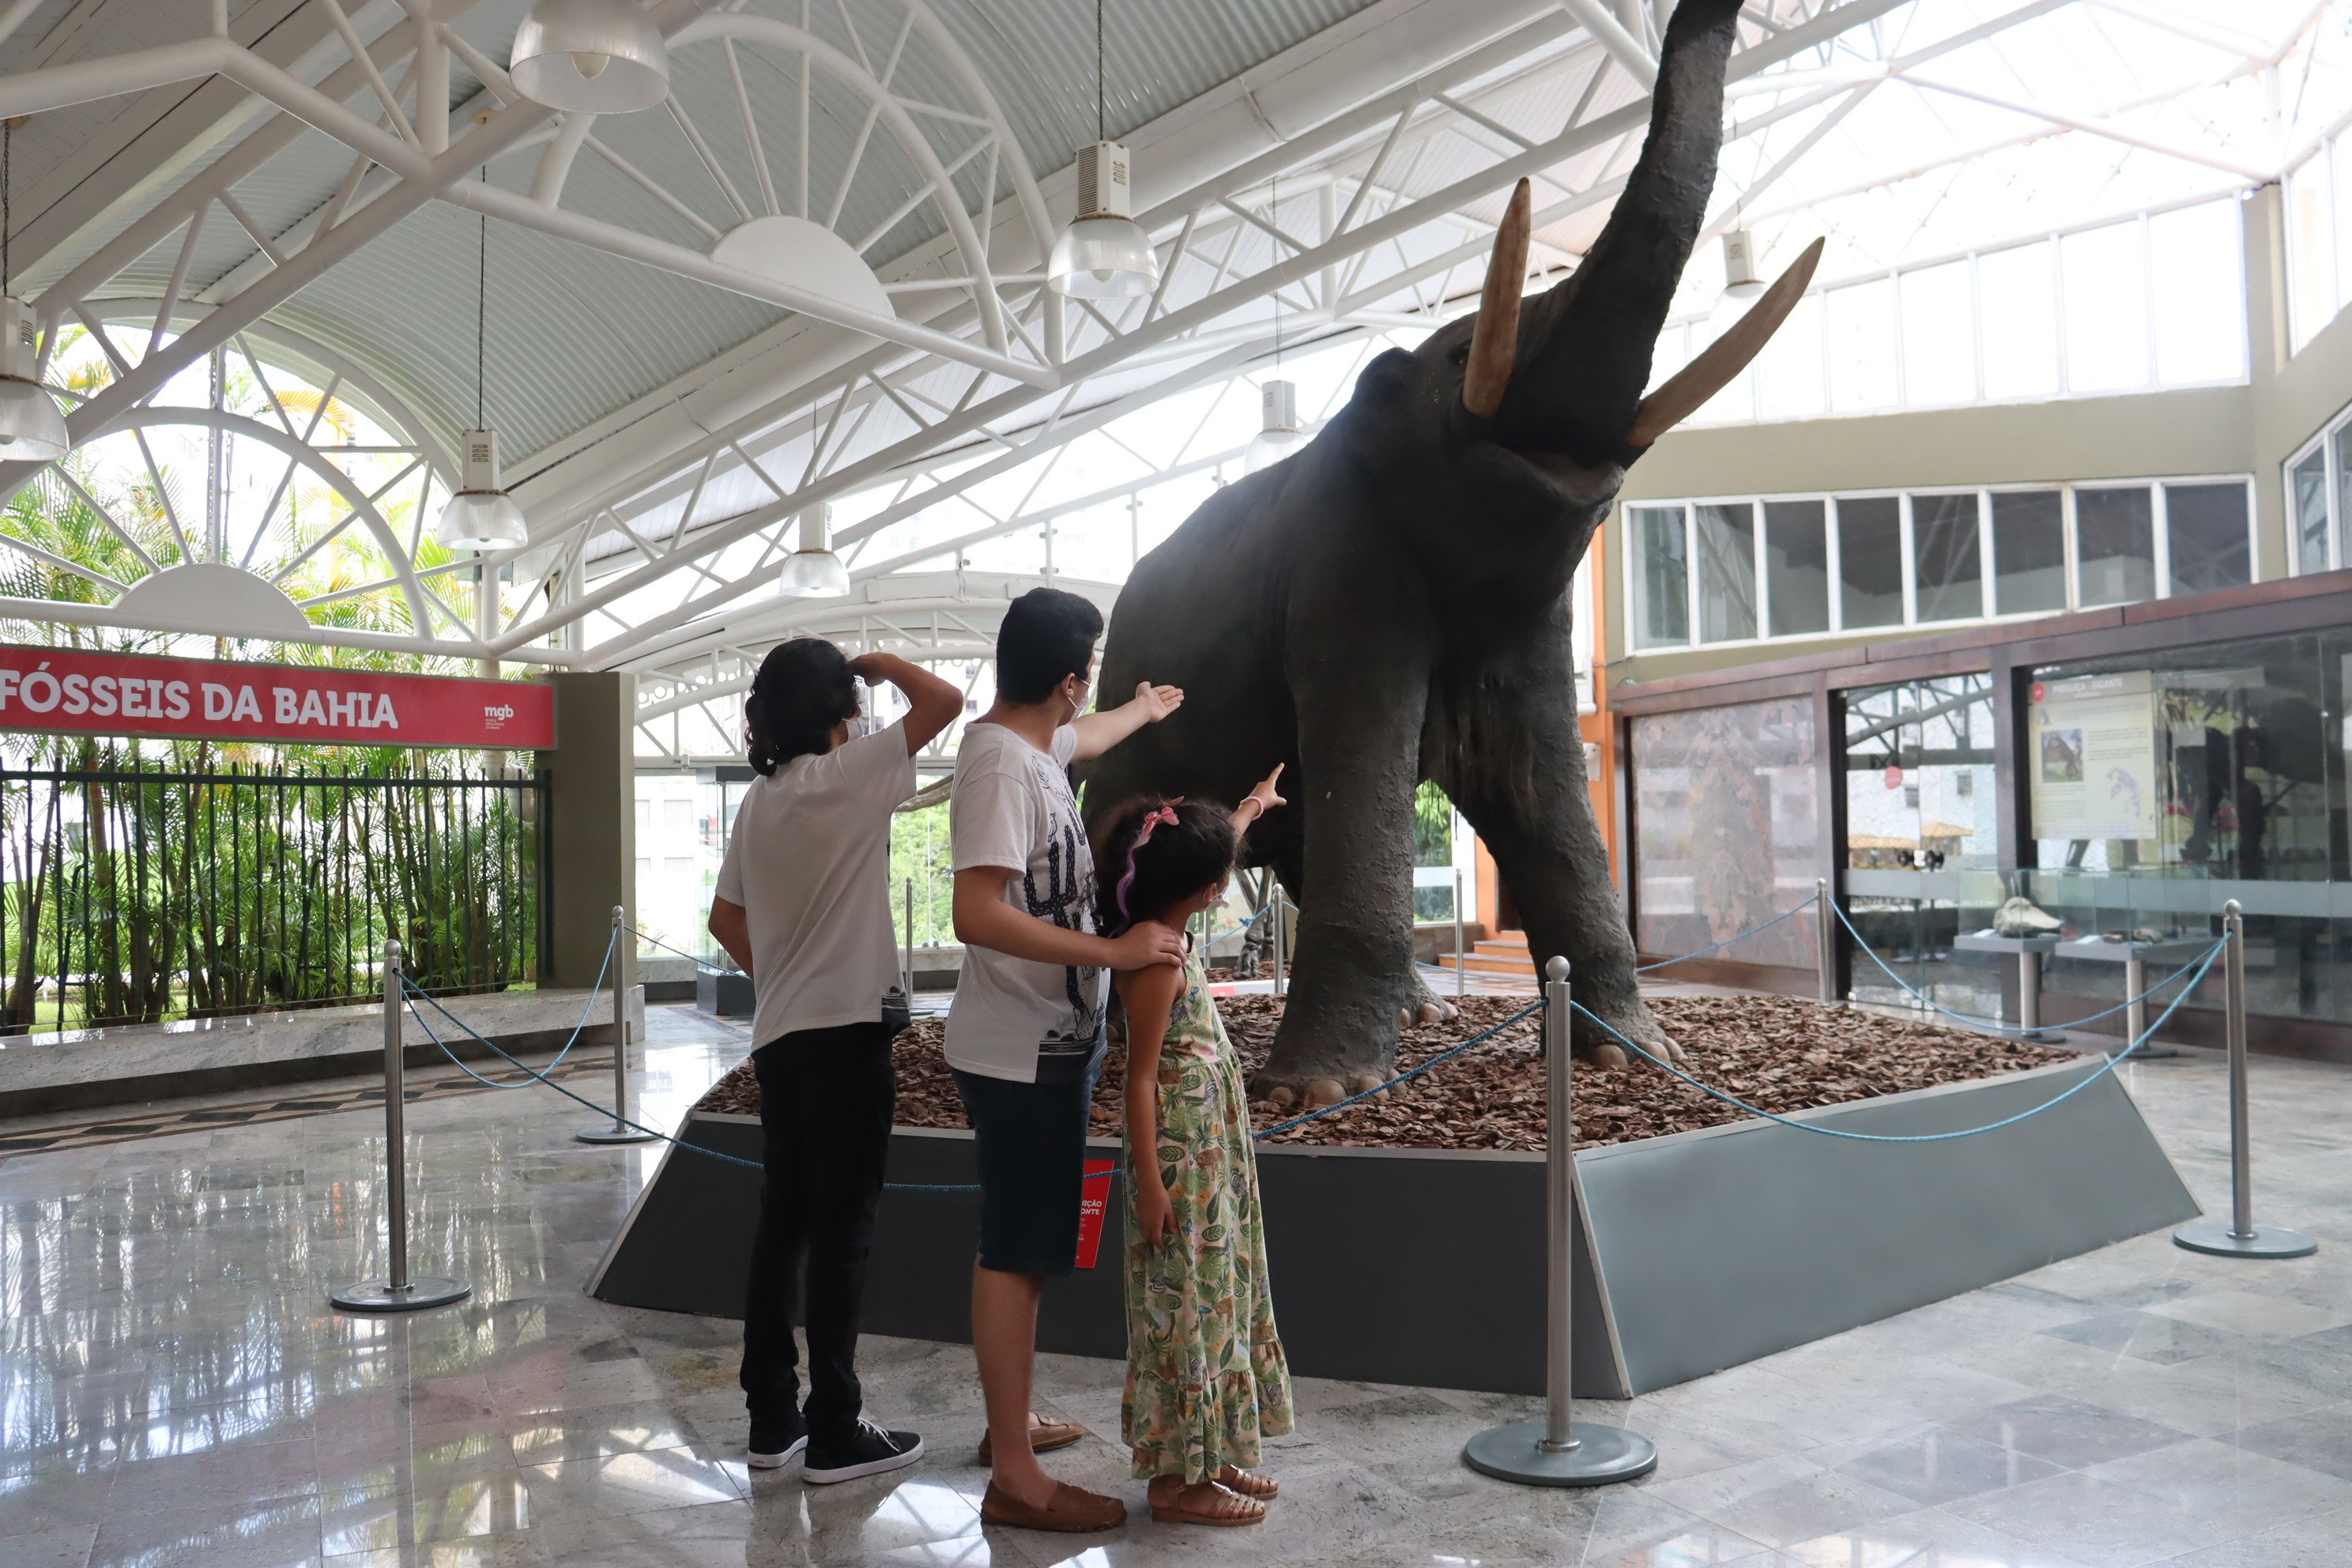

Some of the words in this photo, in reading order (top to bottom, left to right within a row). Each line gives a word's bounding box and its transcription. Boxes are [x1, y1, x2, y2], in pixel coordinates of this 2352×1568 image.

[2091, 678, 2124, 689] GIGANTE
[0, 662, 190, 719] FÓSSEIS
[202, 683, 262, 722] DA
[273, 687, 398, 729] BAHIA
[484, 704, 514, 721] mgb
[1081, 1199, 1102, 1208] IÇÃO
